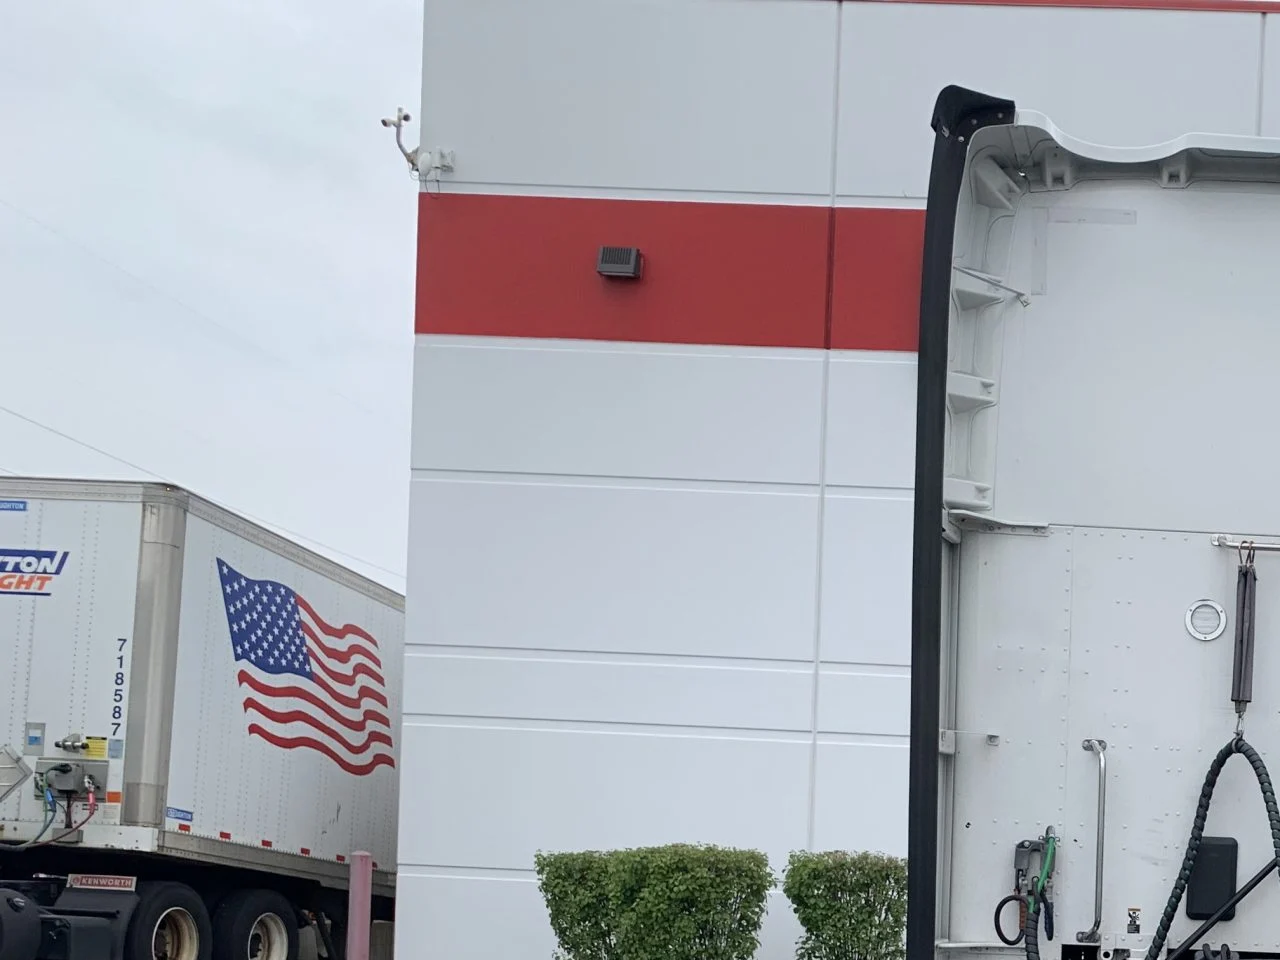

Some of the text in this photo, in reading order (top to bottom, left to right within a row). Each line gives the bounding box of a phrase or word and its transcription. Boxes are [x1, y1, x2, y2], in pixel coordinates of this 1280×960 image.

[0, 552, 62, 574] TON
[111, 638, 127, 736] 718587
[81, 877, 132, 888] KENWORTH
